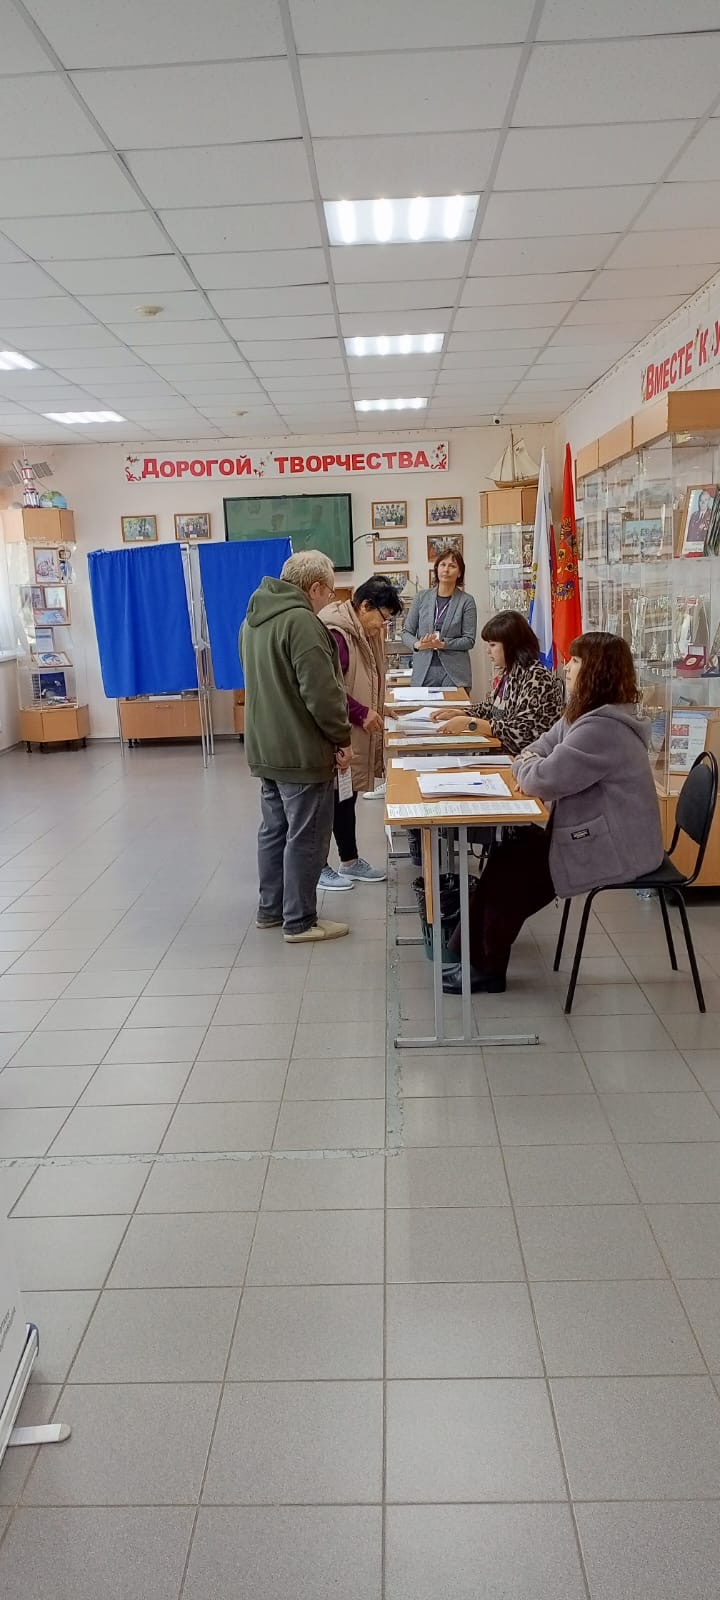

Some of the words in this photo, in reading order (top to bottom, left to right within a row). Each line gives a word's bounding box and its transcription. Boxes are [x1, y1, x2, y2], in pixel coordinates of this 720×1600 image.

[645, 340, 694, 401] ВМЕСТЕ
[699, 327, 709, 367] К
[141, 454, 253, 479] ДОРОГОЙ
[274, 450, 430, 474] ТВОРЧЕСТВА
